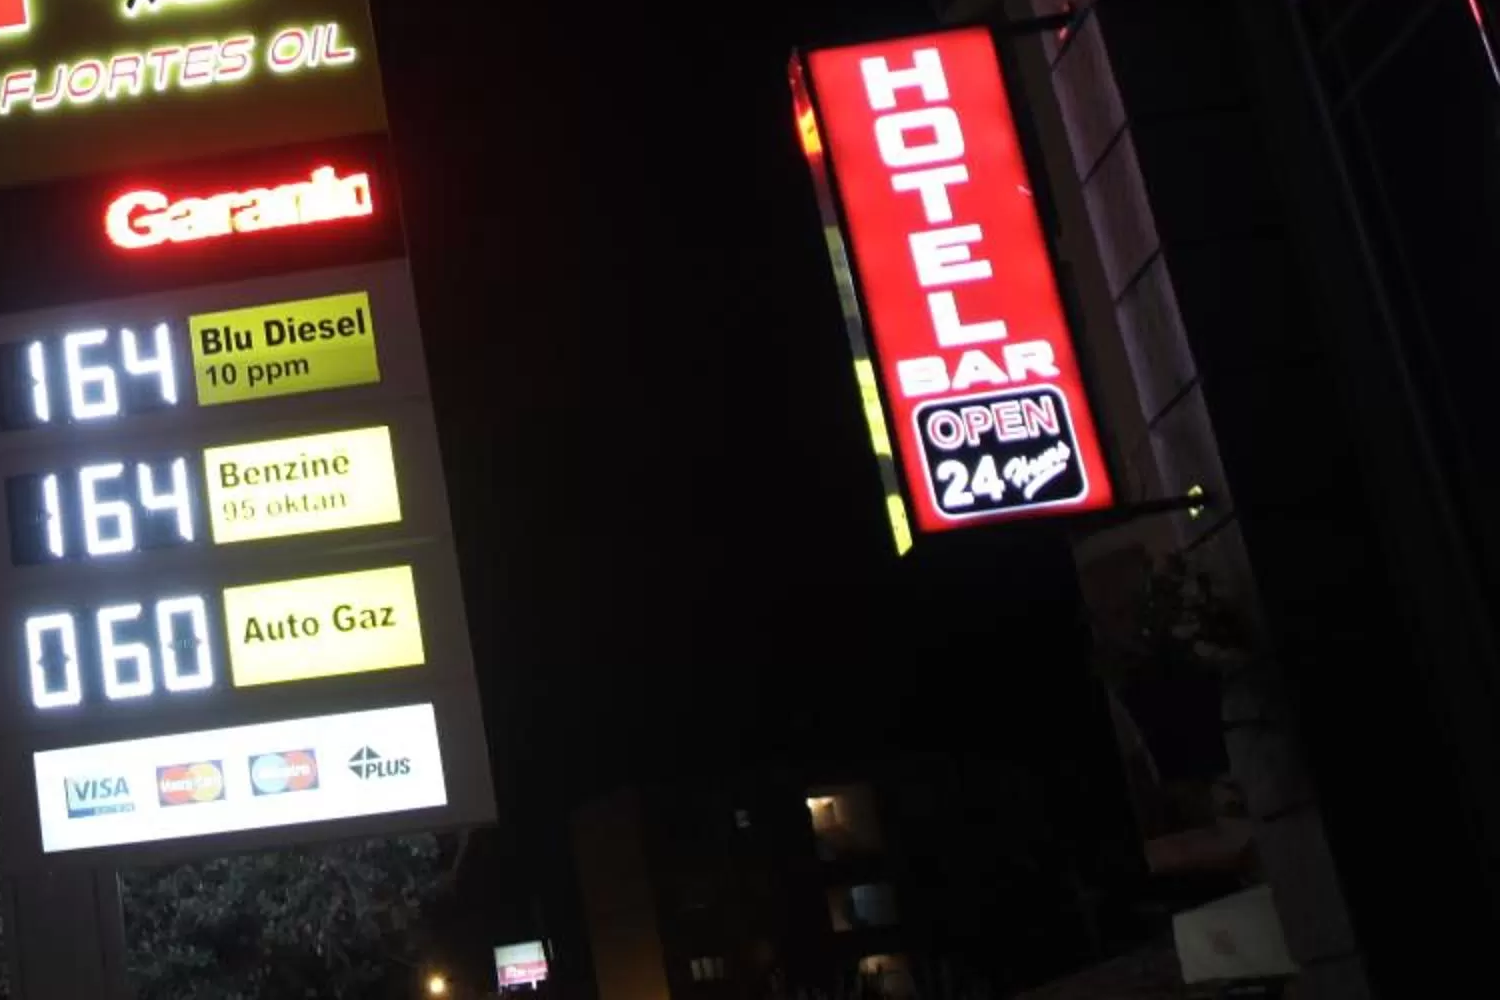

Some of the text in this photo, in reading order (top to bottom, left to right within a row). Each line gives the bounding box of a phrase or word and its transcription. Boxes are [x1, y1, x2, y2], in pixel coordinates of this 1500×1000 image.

[0, 23, 357, 113] FJORTES OIL
[860, 47, 1008, 349] HOTEL
[200, 307, 366, 356] Blu Diesel
[27, 322, 178, 423] 164
[205, 357, 310, 387] 10 ppm
[896, 340, 1060, 398] BAR
[926, 395, 1061, 450] OPEN
[41, 457, 195, 557] 164
[222, 492, 348, 521] 95 oktan
[936, 454, 1006, 508] 24
[242, 603, 398, 646] Auto Gaz
[25, 594, 214, 710] 060
[73, 776, 131, 802] VISA
[365, 756, 411, 780] PLUS
